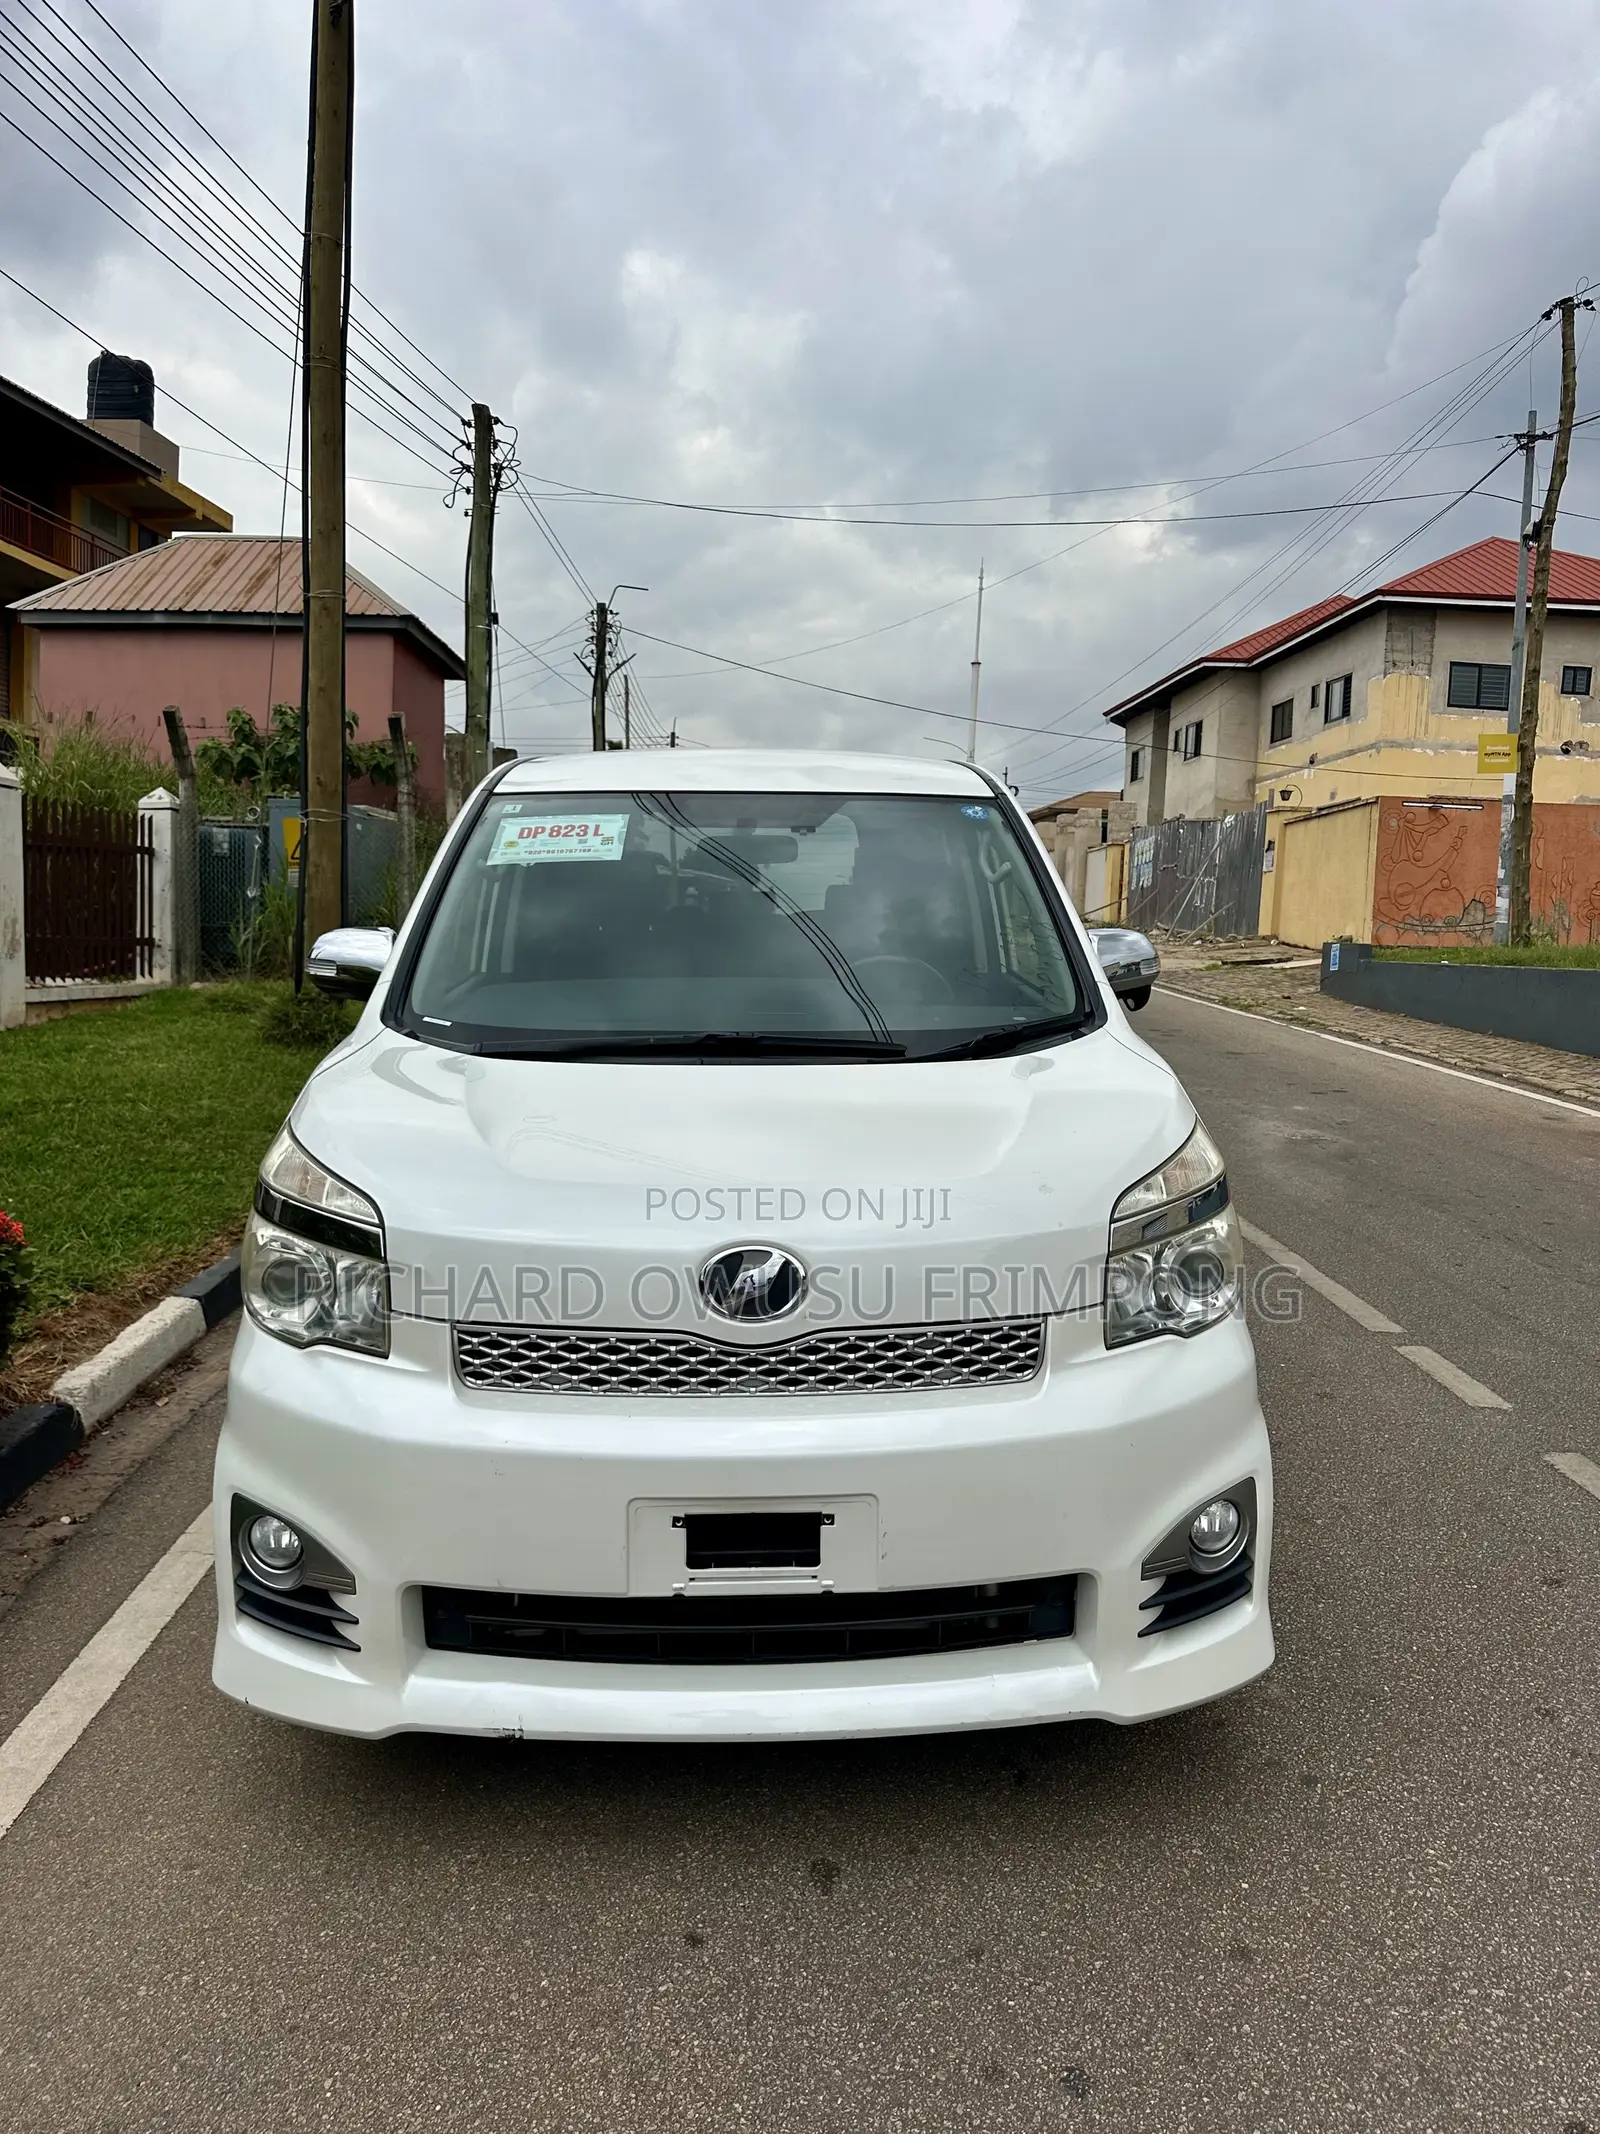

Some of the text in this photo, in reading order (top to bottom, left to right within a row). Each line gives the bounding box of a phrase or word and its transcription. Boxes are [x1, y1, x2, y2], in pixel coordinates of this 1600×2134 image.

[518, 824, 605, 839] DP 823 L
